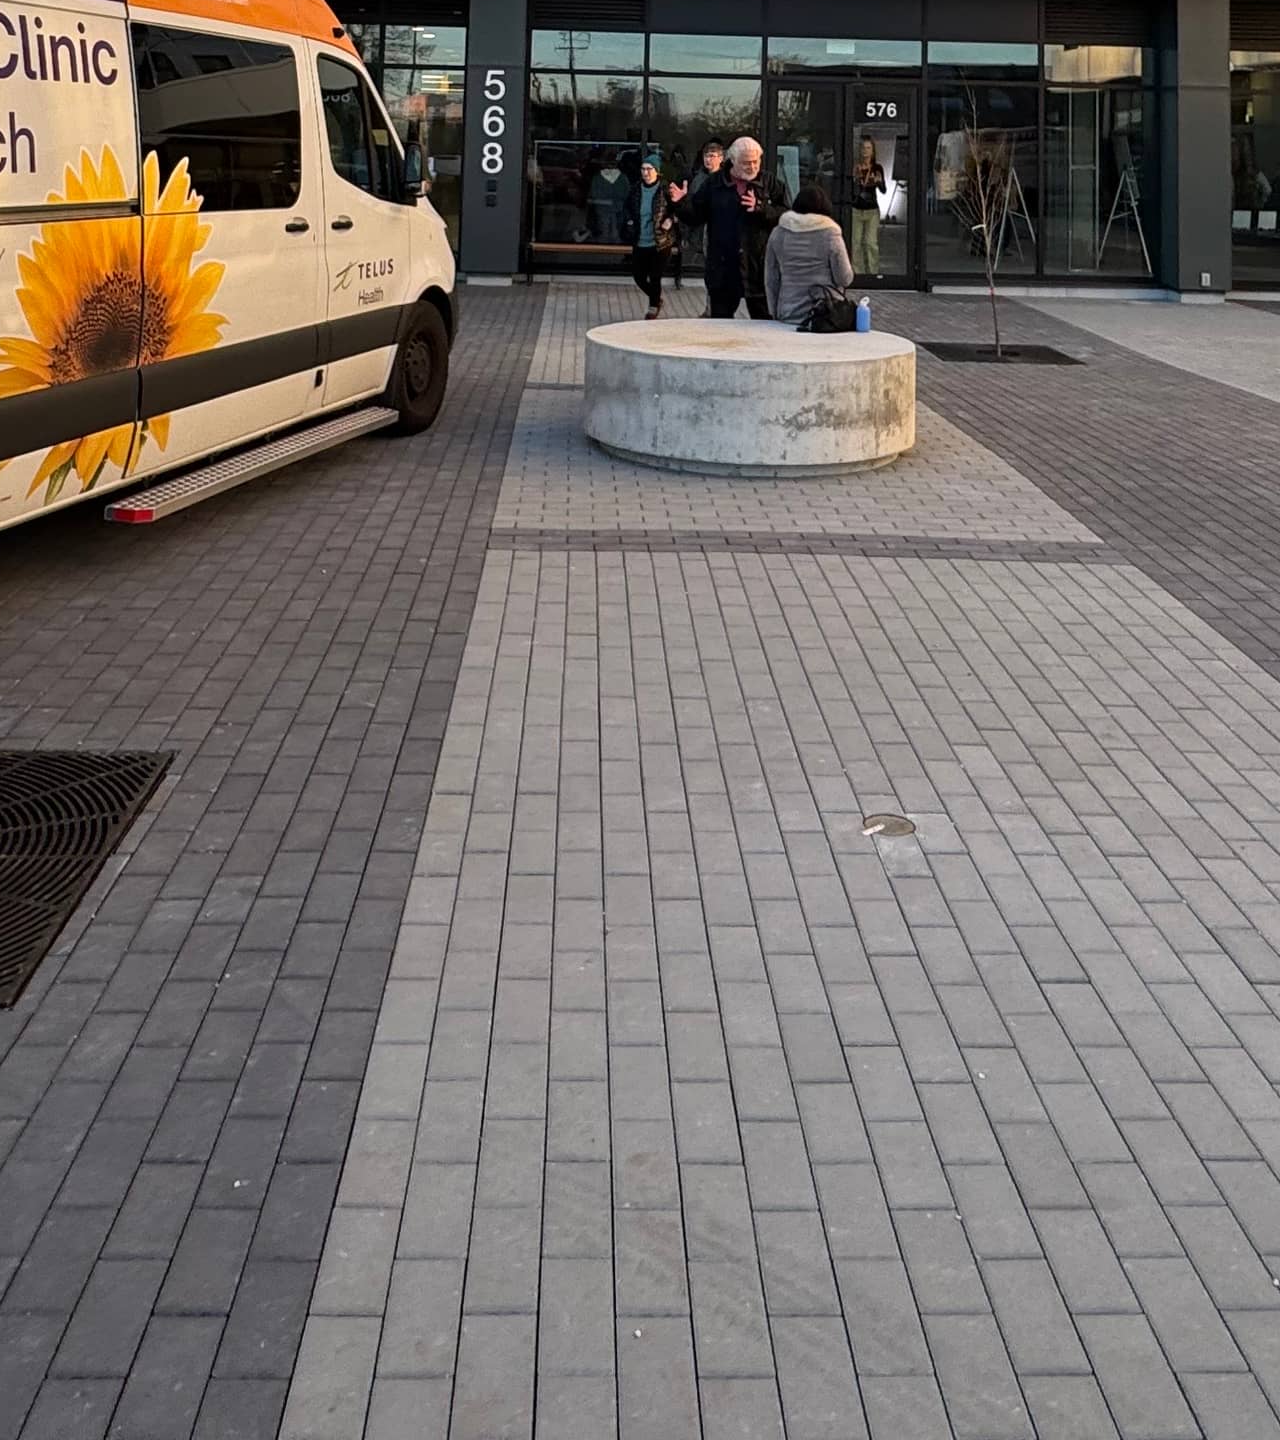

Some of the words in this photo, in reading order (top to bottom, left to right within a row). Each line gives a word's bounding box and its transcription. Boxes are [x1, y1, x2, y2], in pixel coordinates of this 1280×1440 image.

[865, 101, 897, 117] 576
[481, 69, 507, 175] 568
[358, 258, 394, 280] TELUS
